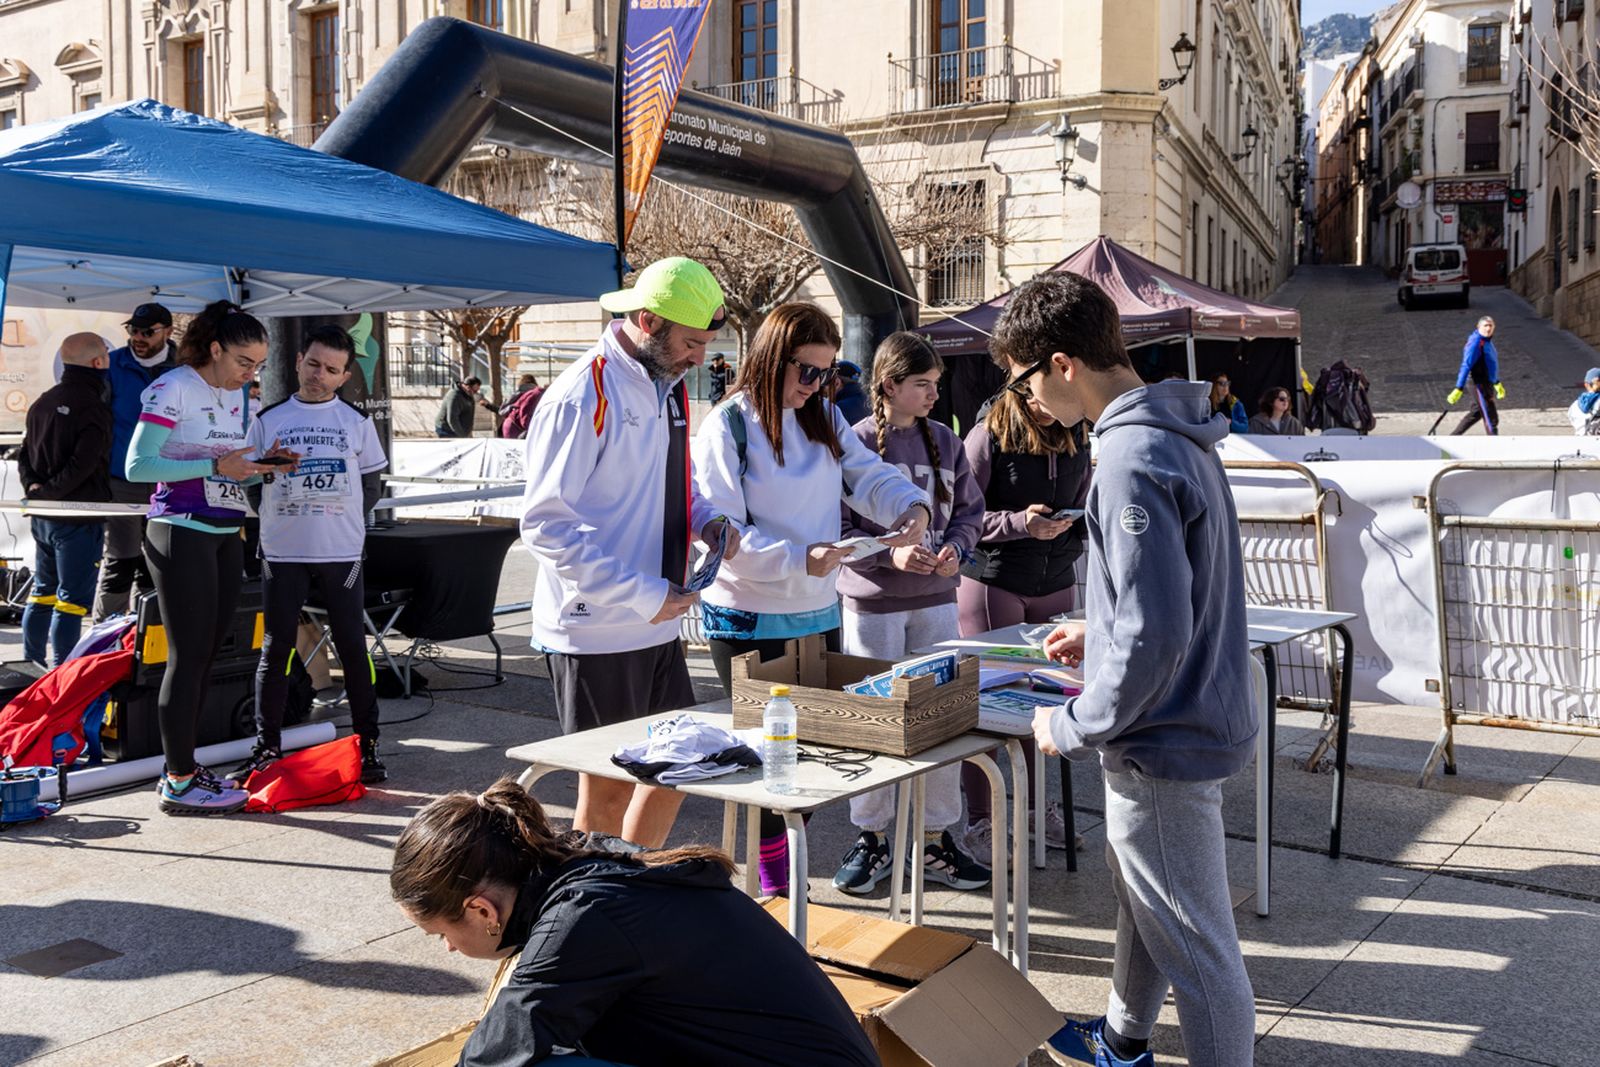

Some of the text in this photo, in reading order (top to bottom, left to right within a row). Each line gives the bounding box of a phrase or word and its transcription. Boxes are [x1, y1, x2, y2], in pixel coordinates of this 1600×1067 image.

[670, 111, 767, 146] tronato Municipal de
[663, 128, 742, 157] eportes de Jaén
[280, 435, 335, 447] UENA MUERTE
[302, 473, 336, 489] 467
